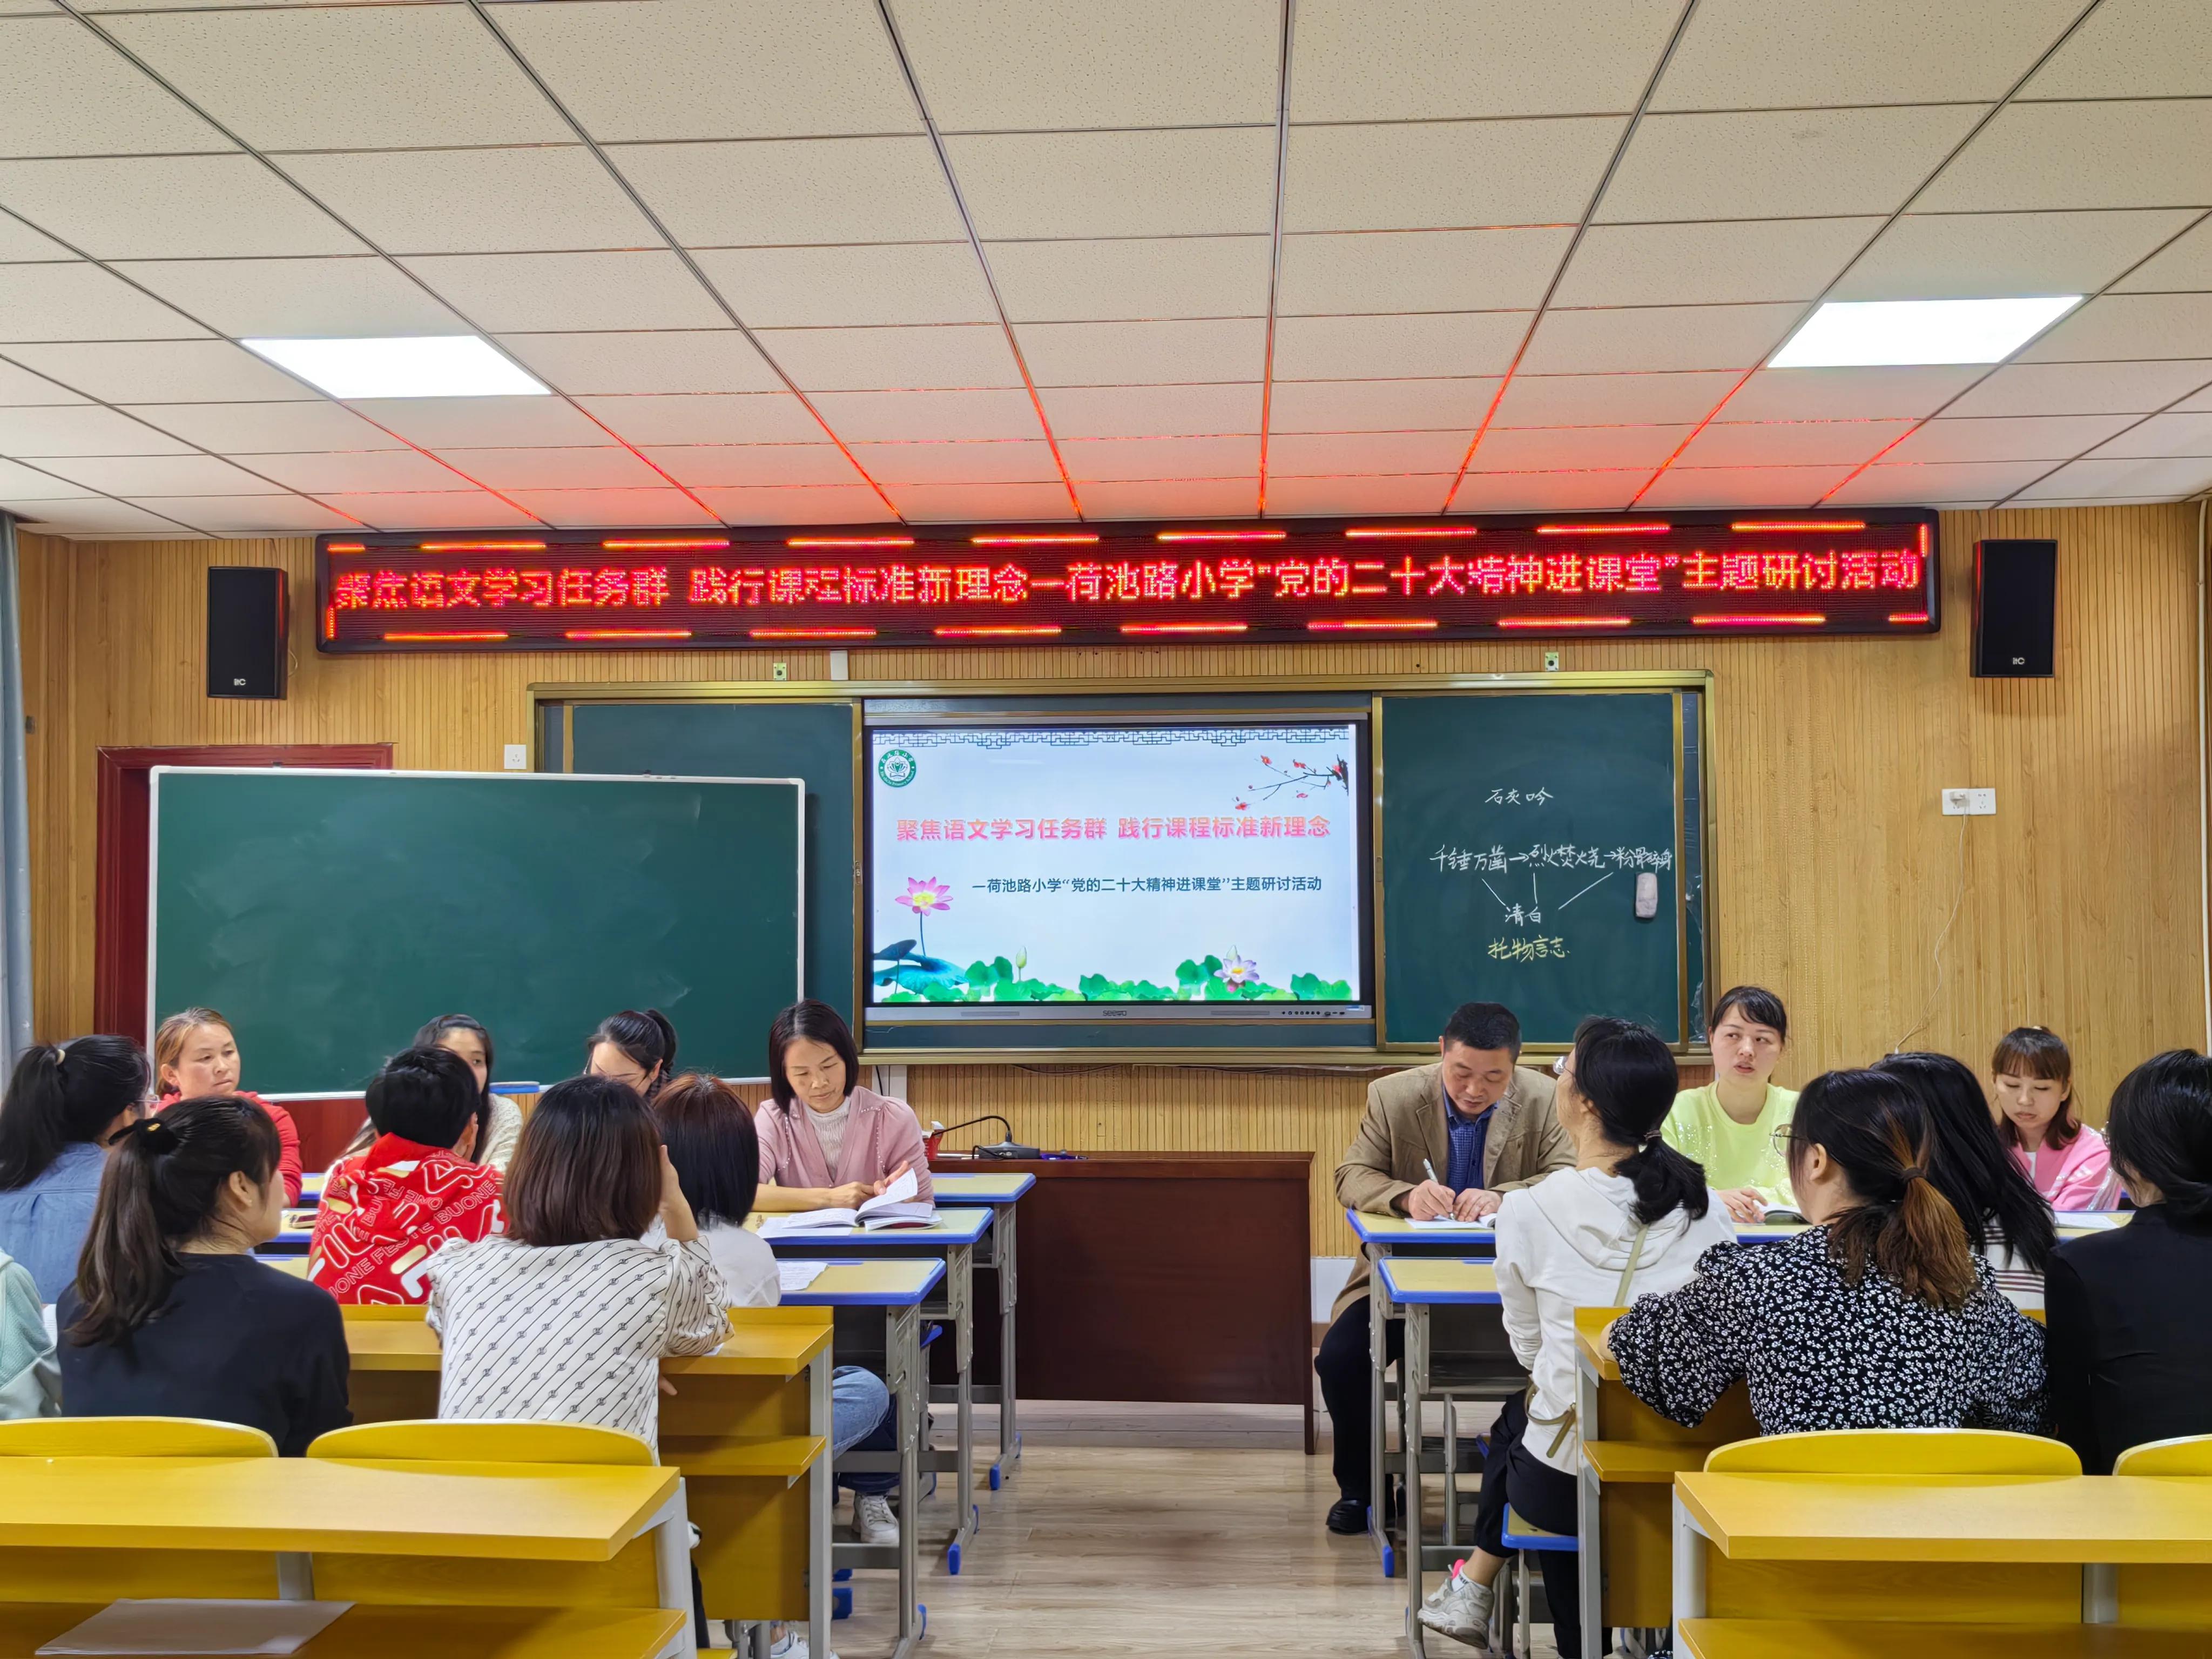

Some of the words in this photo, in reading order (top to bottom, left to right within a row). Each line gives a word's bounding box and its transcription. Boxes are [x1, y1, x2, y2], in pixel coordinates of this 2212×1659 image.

[335, 565, 670, 609] 聚焦语文学习任务群
[1485, 786, 1554, 806] 石灰吟
[897, 818, 1107, 841] 聚焦语文学习任务群
[1118, 815, 1331, 839] 践行课程标准新理念
[1505, 903, 1541, 926] 清白
[434, 1180, 497, 1225] BUONE
